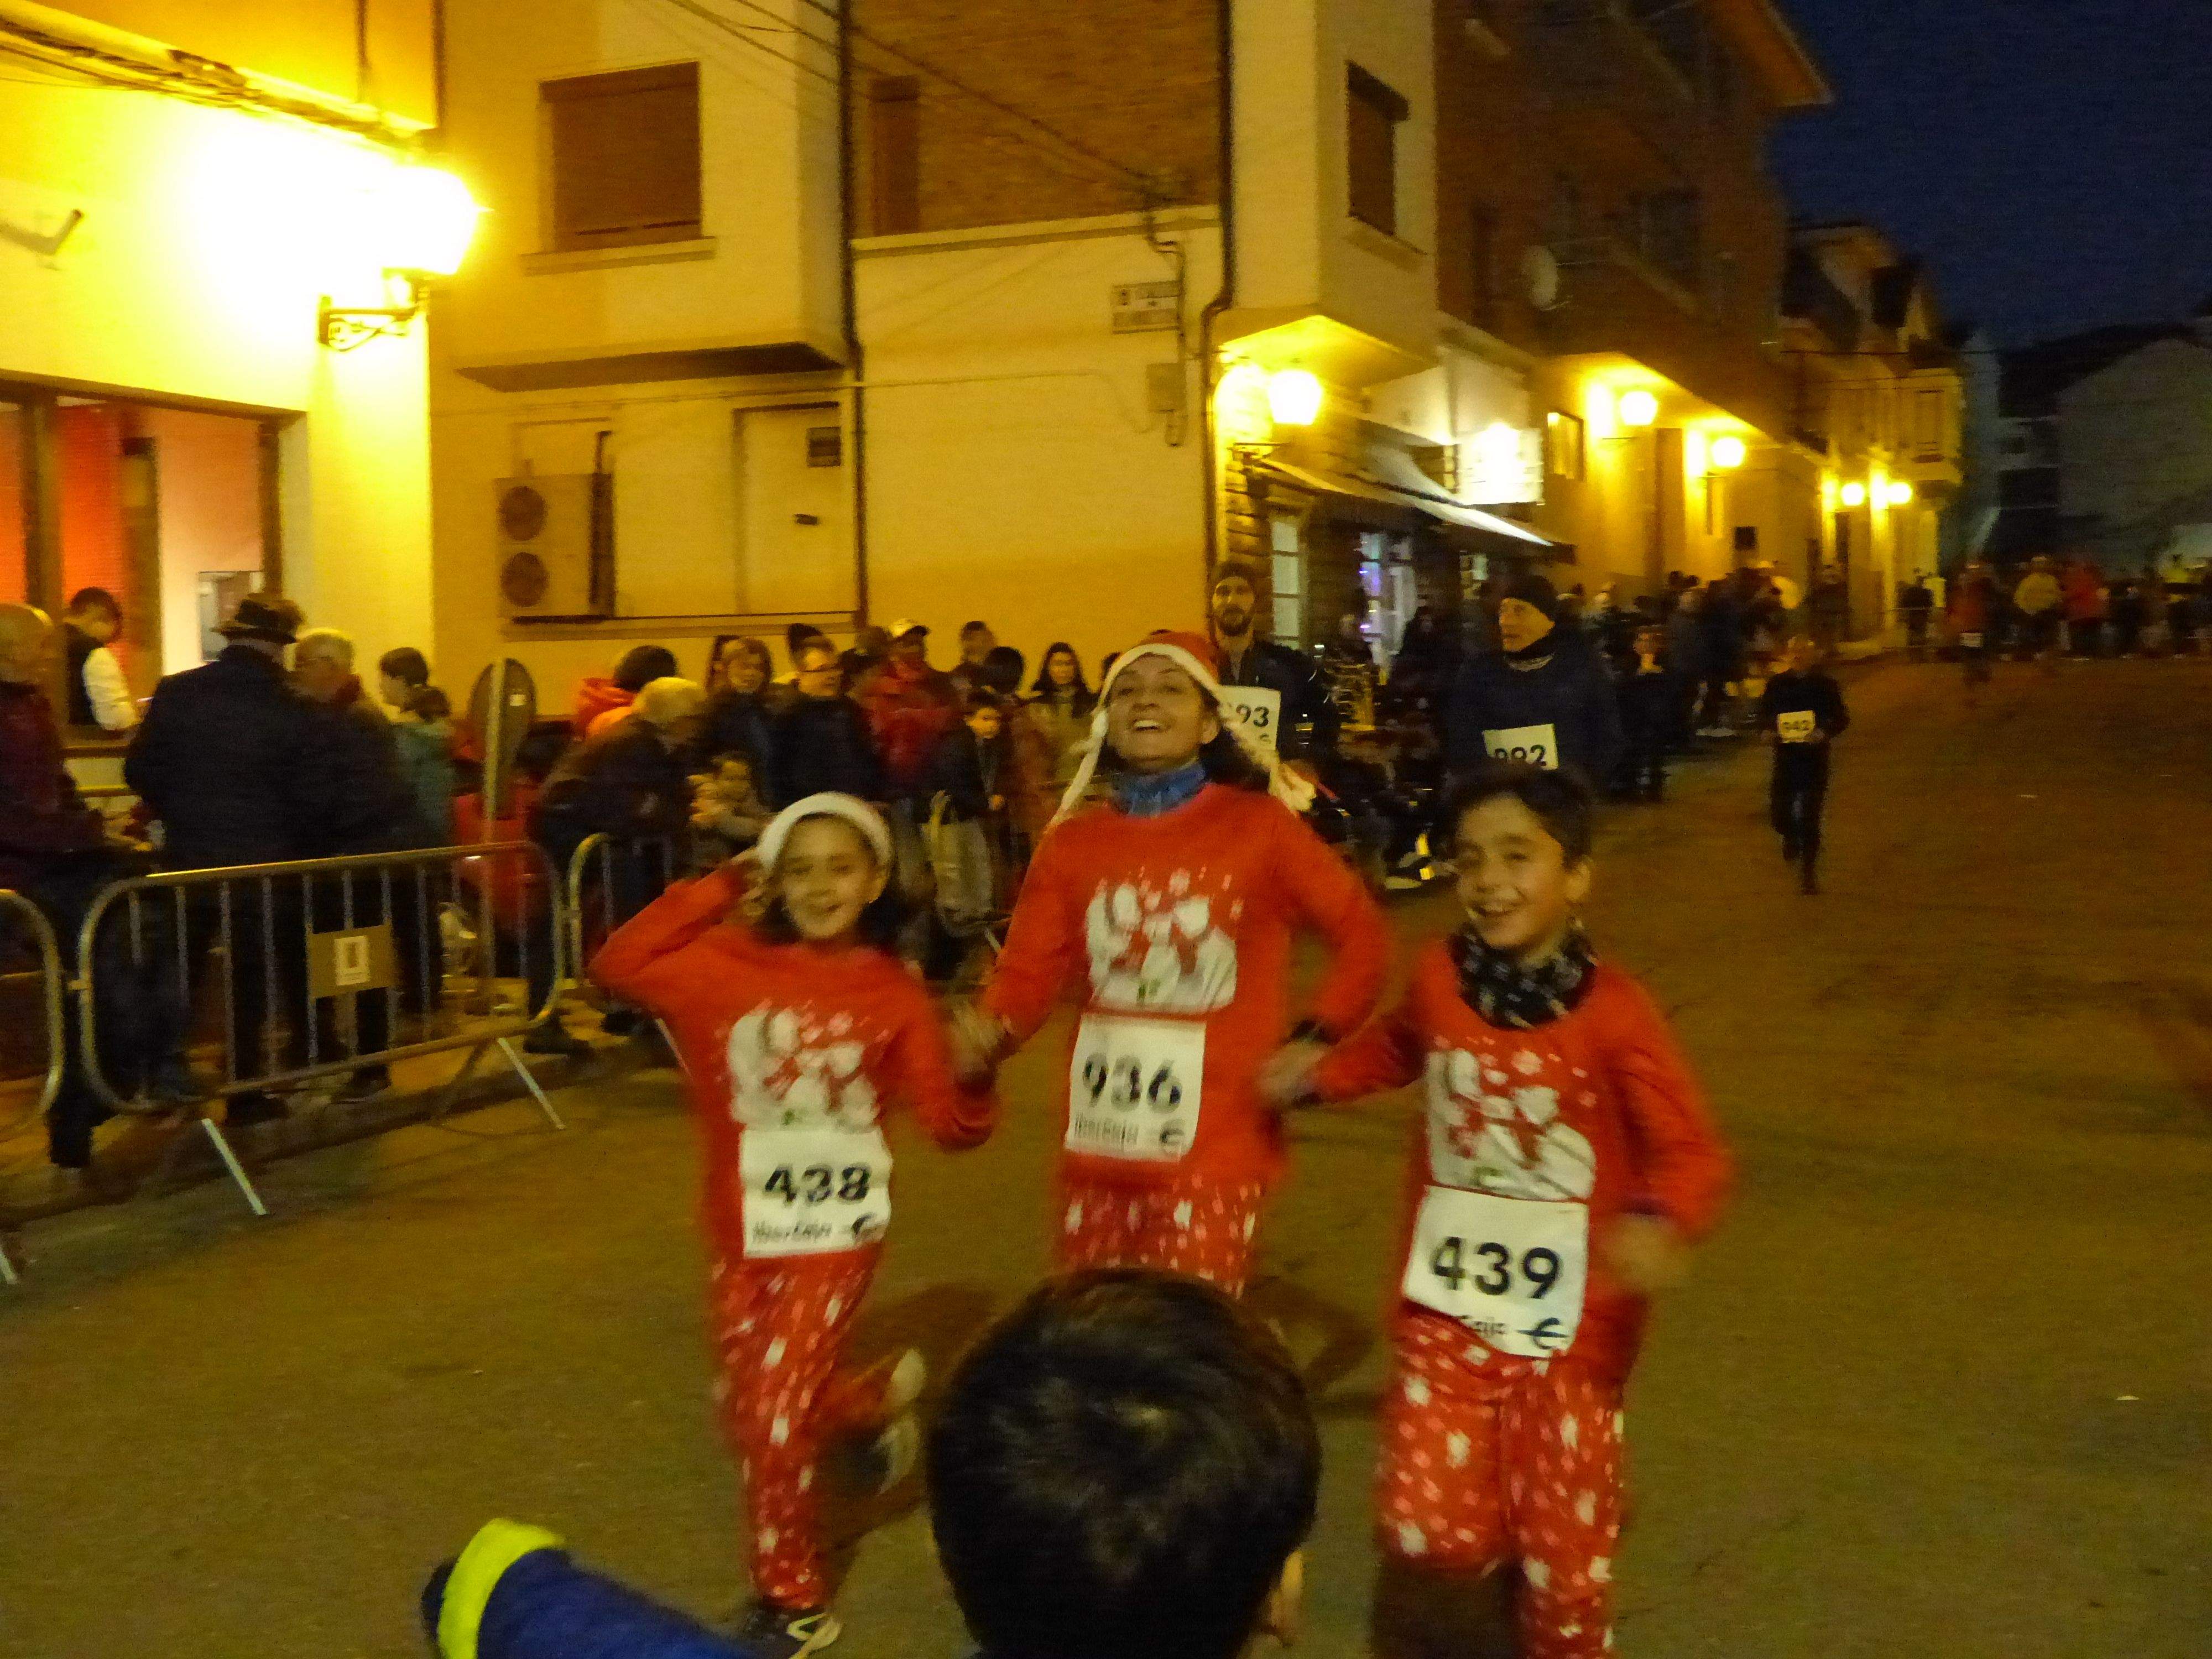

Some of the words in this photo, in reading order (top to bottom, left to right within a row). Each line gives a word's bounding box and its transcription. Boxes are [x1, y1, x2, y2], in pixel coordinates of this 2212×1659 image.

[1228, 704, 1270, 727] 93
[1083, 1052, 1182, 1114] 936
[763, 1164, 872, 1207] 438
[1429, 1236, 1564, 1300] 439
